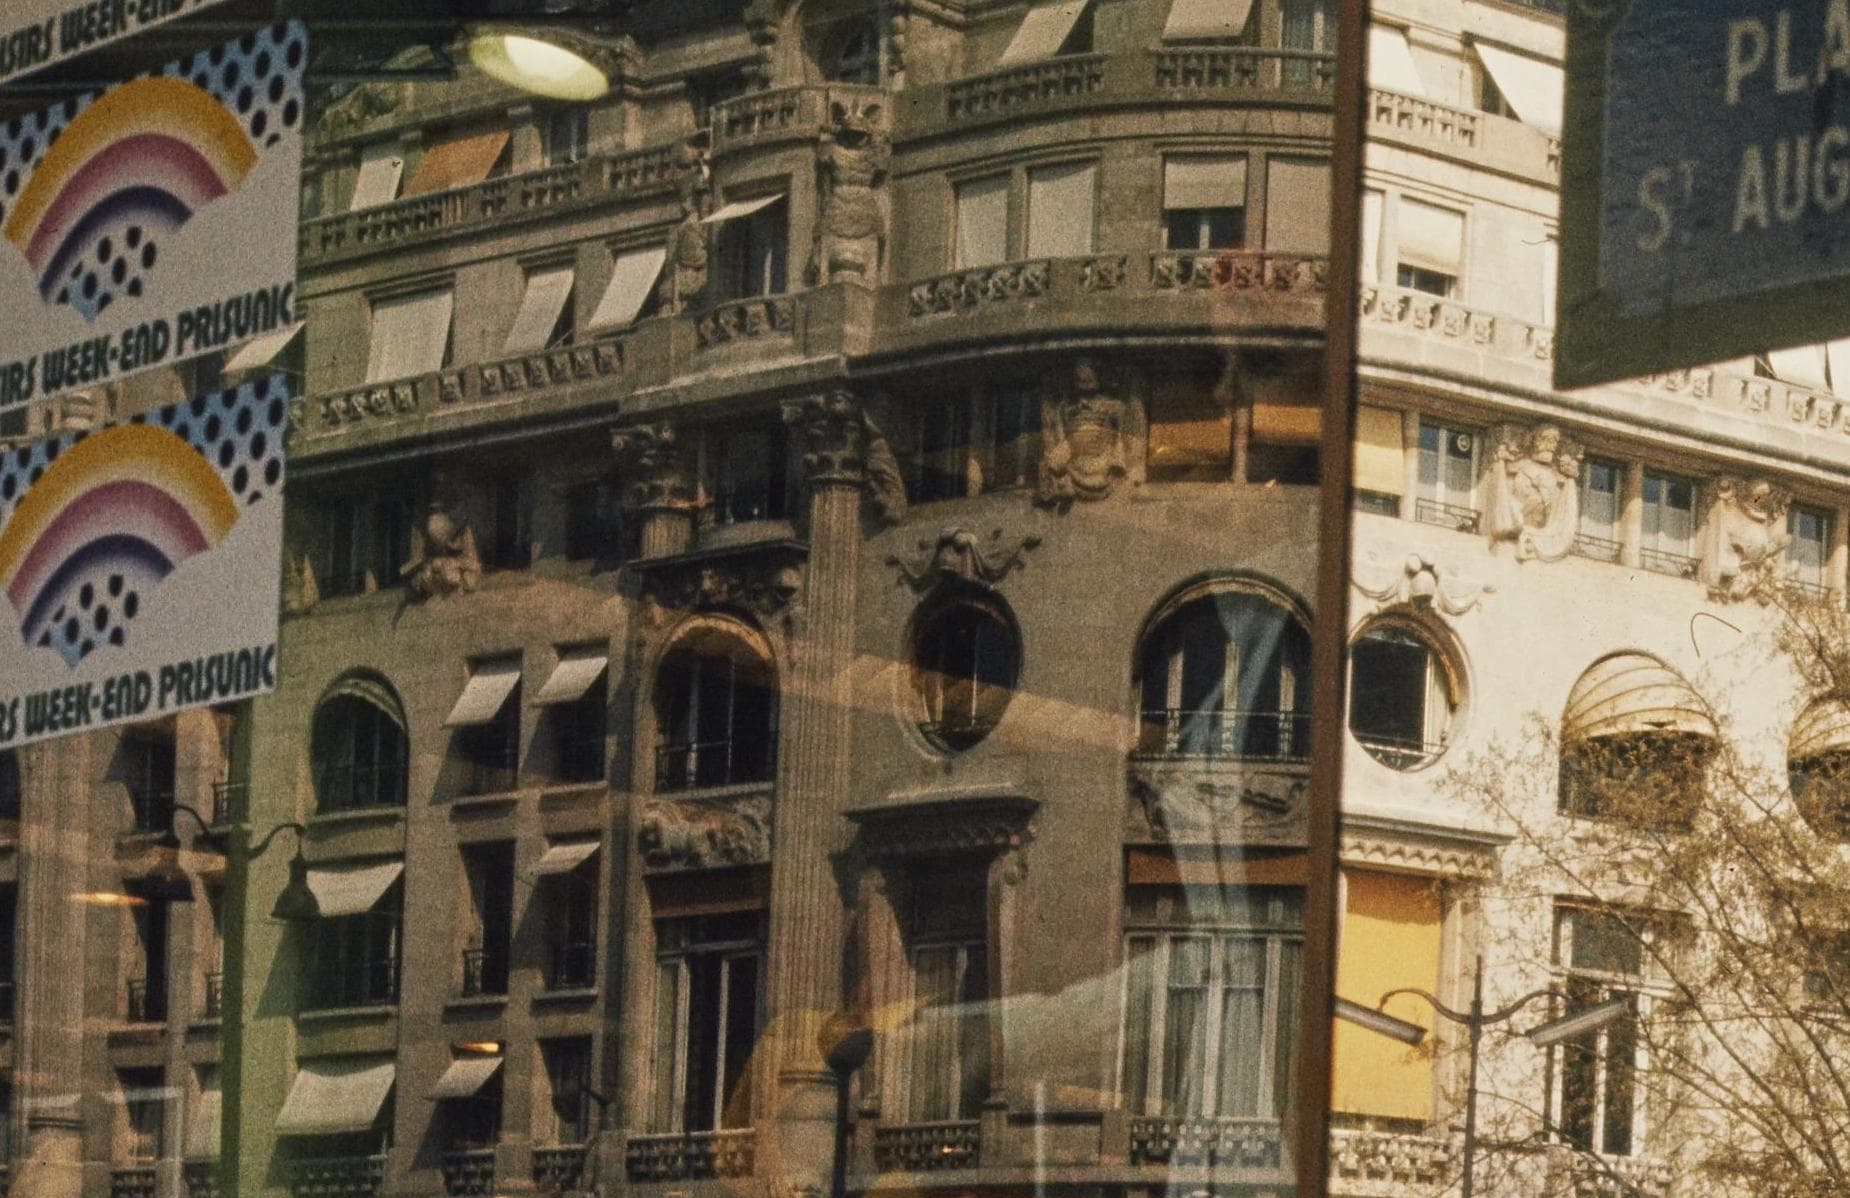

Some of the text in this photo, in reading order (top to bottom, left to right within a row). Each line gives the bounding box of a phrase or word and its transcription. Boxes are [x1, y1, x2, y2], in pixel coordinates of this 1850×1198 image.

[41, 319, 170, 394] WEEK-END
[176, 282, 293, 356] PRISUNIC
[24, 670, 151, 737] WEEK-END
[157, 643, 275, 709] PRISUNIC
